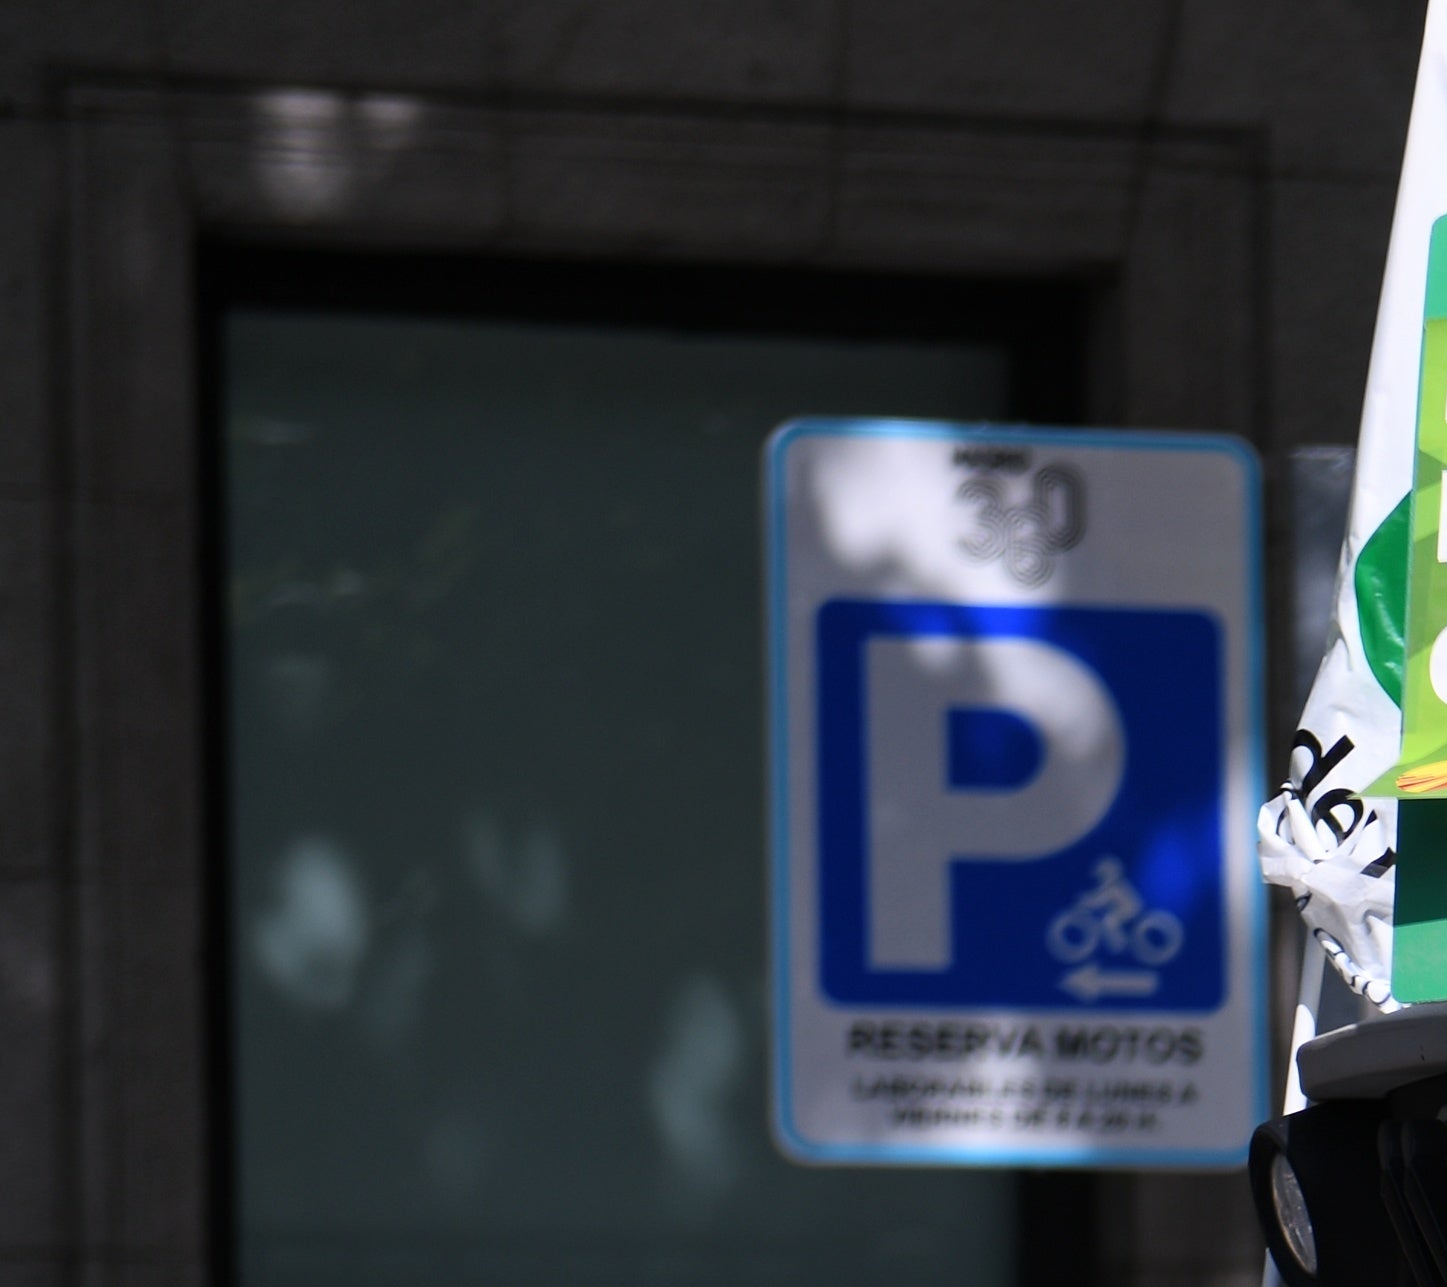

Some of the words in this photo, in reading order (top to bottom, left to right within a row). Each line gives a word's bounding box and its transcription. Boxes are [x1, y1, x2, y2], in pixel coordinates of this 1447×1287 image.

[865, 634, 1125, 973] P
[848, 1021, 1043, 1060] RESERVA
[1051, 1024, 1204, 1065] MOTOS
